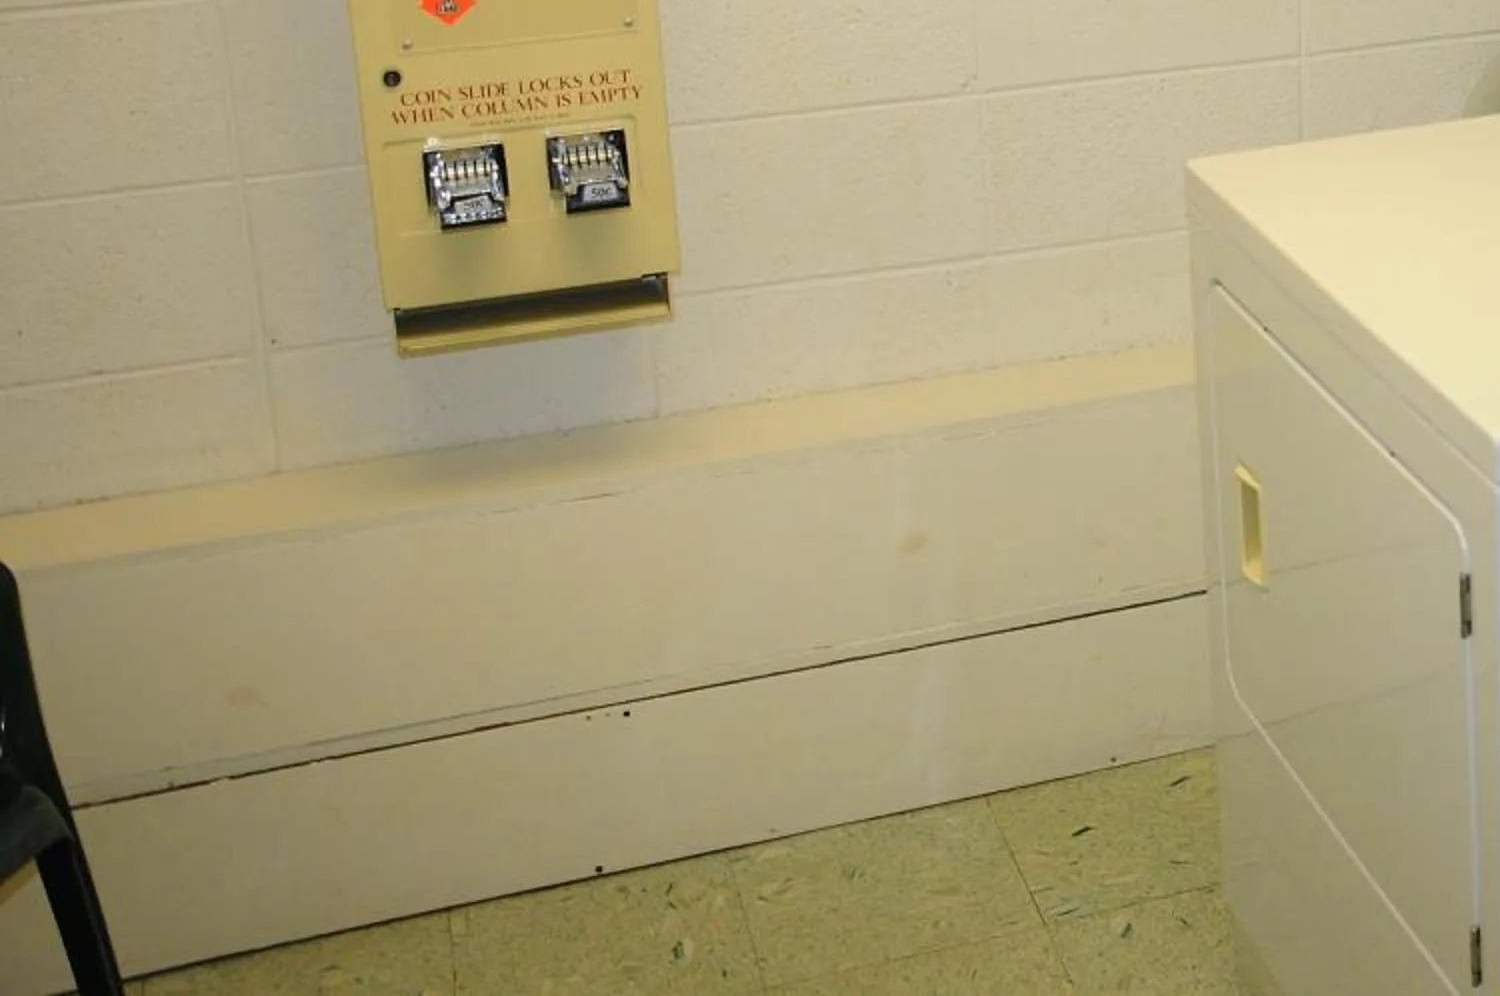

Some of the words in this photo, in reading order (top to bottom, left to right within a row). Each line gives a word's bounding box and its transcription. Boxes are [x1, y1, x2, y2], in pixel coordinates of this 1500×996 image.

[391, 106, 454, 126] WHEN
[461, 96, 549, 119] COLUMN
[556, 95, 574, 108] IS
[579, 85, 643, 106] EMPTY
[401, 89, 452, 107] COIN
[458, 81, 509, 101] SLIDE
[519, 77, 583, 95] LOCKS
[589, 69, 631, 87] OUT
